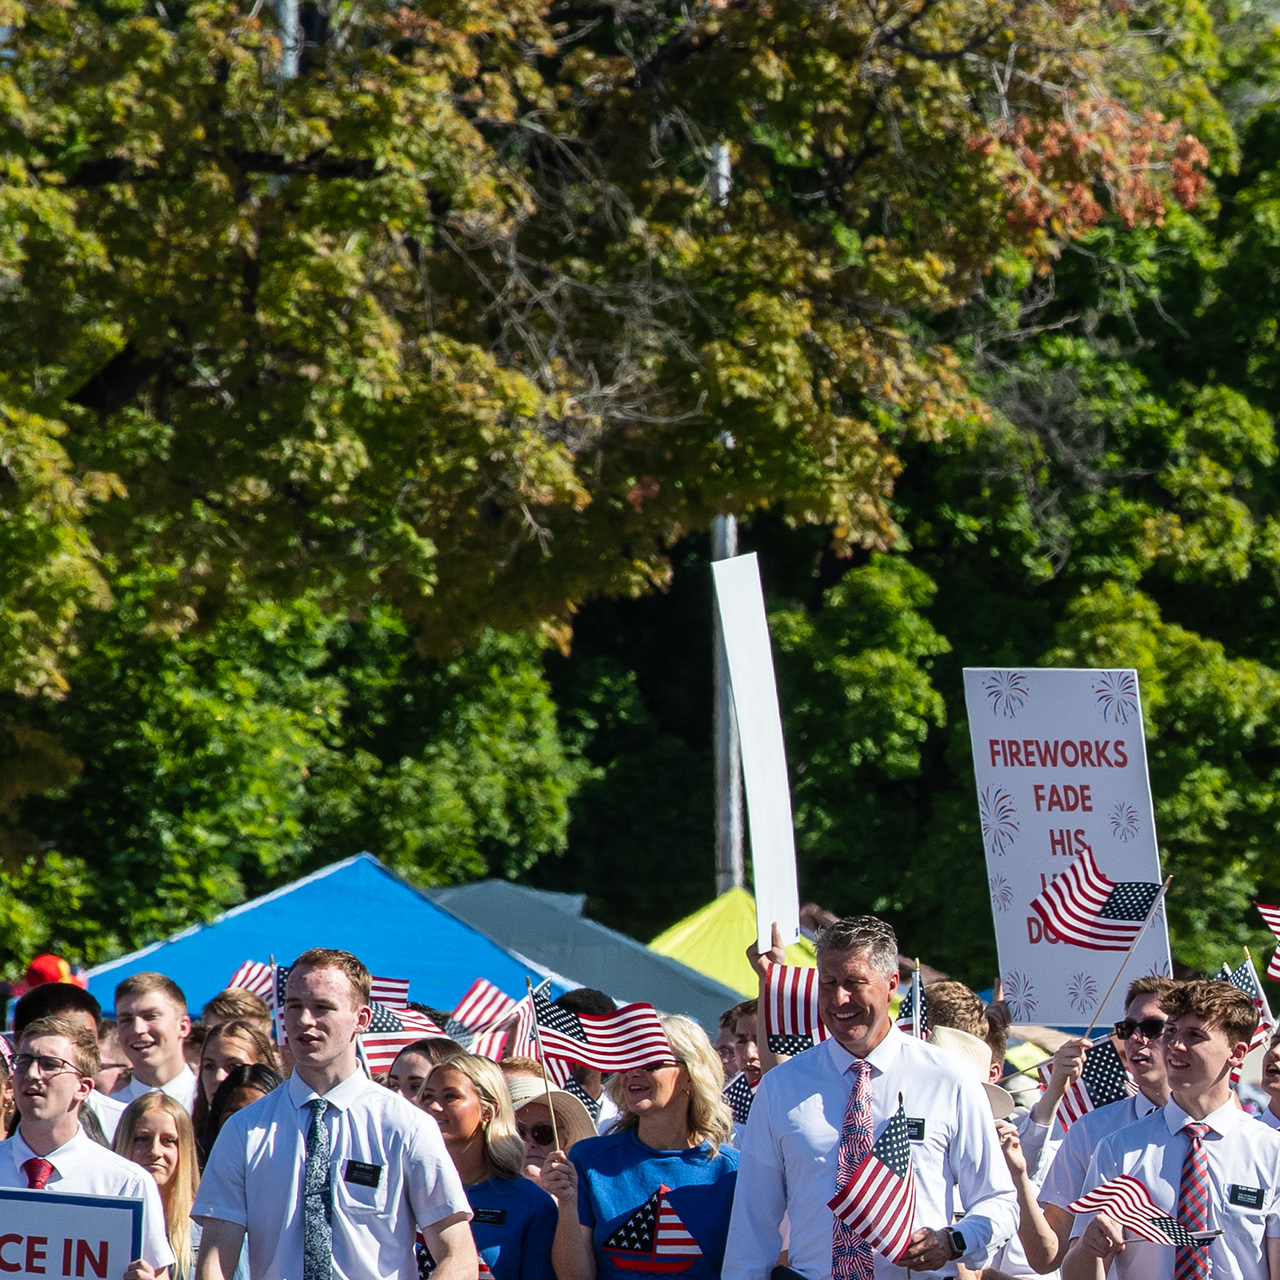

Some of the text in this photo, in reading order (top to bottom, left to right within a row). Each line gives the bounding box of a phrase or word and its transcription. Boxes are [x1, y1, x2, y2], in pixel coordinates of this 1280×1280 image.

[989, 739, 1128, 768] FIREWORKS
[1033, 785, 1093, 812] FADE
[1049, 829, 1088, 856] HIS
[62, 1238, 109, 1279] IN
